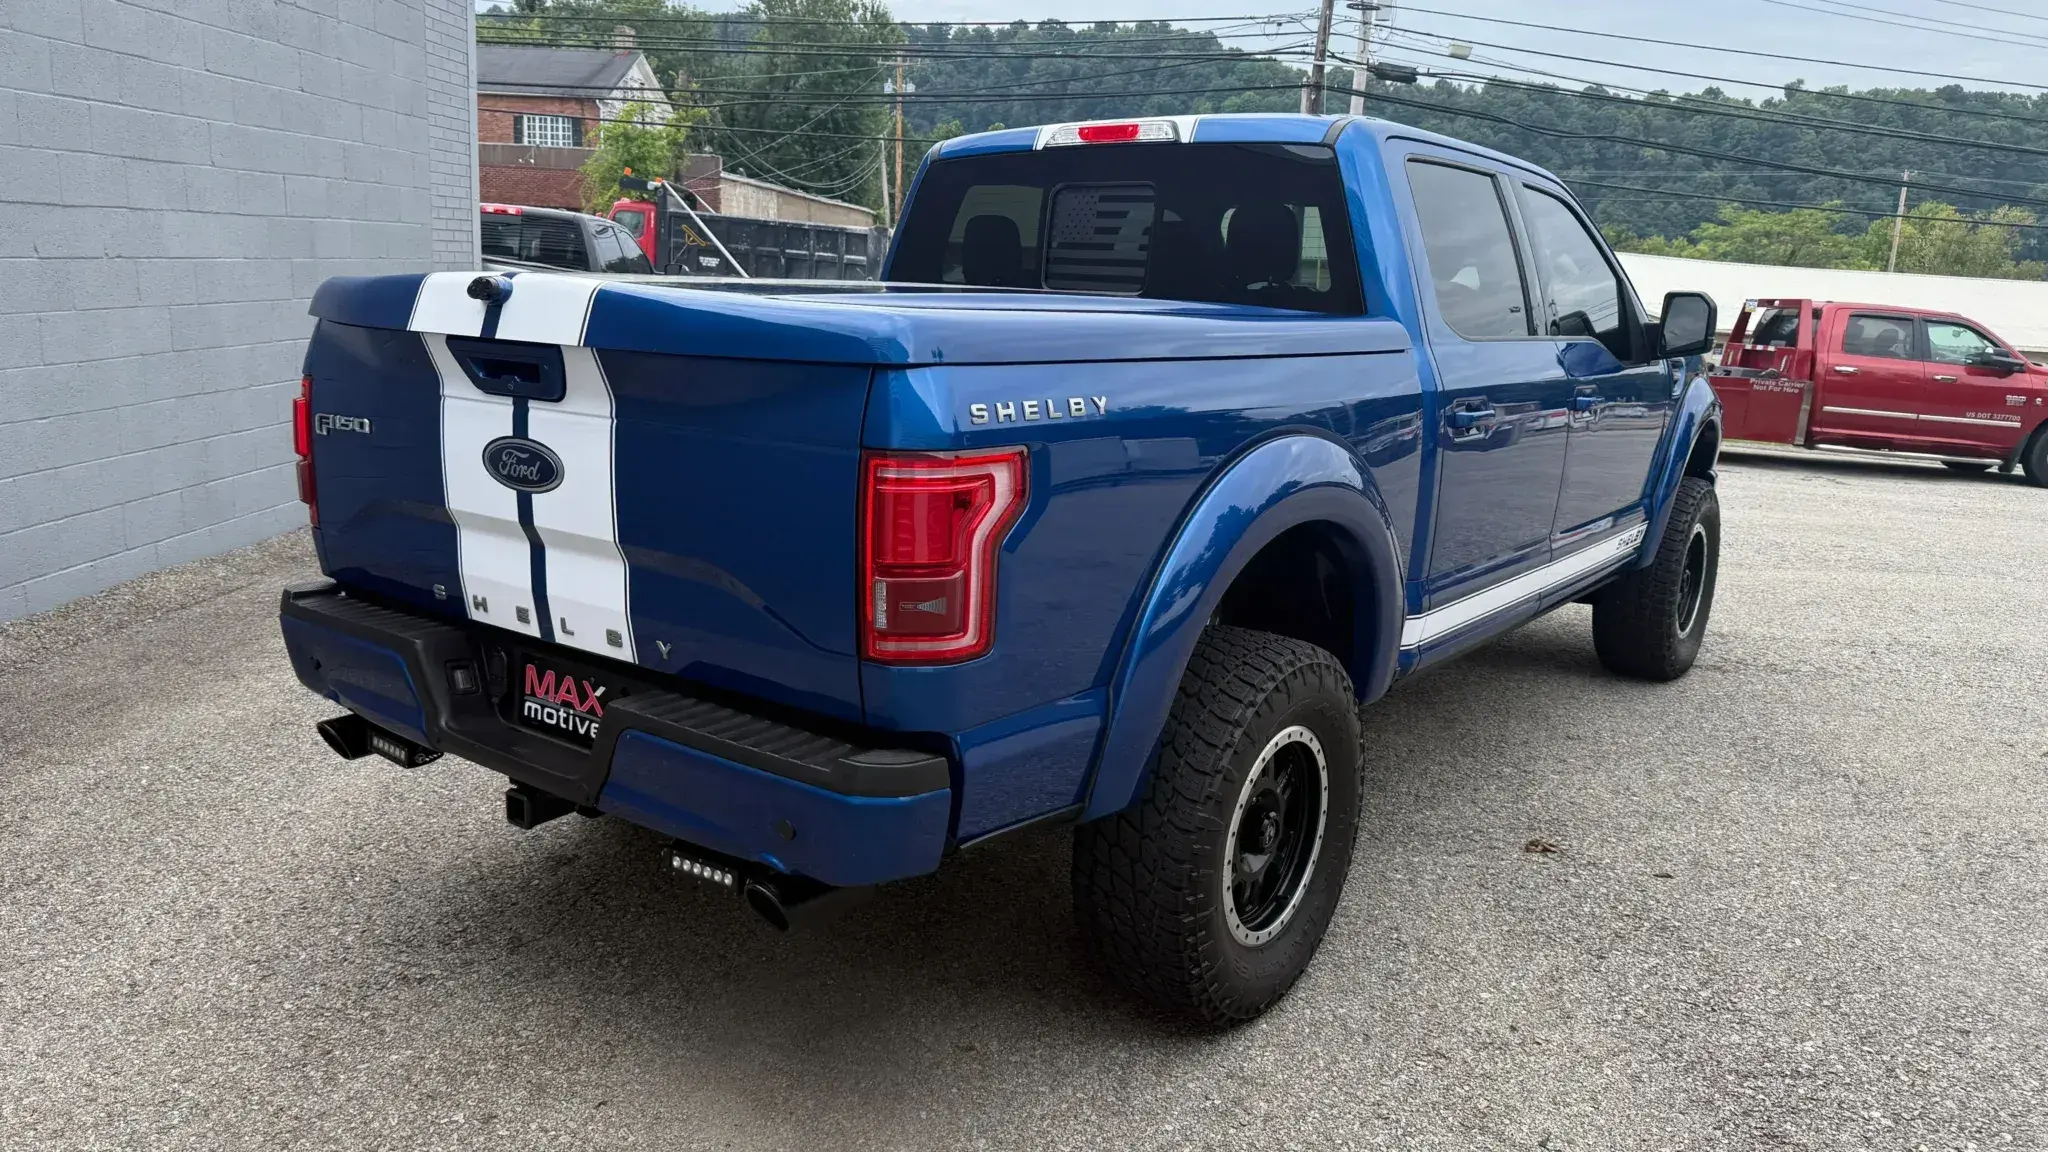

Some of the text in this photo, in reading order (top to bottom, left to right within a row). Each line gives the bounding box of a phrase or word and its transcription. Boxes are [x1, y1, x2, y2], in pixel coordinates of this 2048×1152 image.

[1750, 378, 1805, 388] Private Carrier
[970, 396, 1107, 425] SHELBY
[499, 449, 540, 480] Ford
[1616, 529, 1643, 550] SHELBY
[525, 664, 605, 717] MAX
[524, 701, 599, 738] motive
